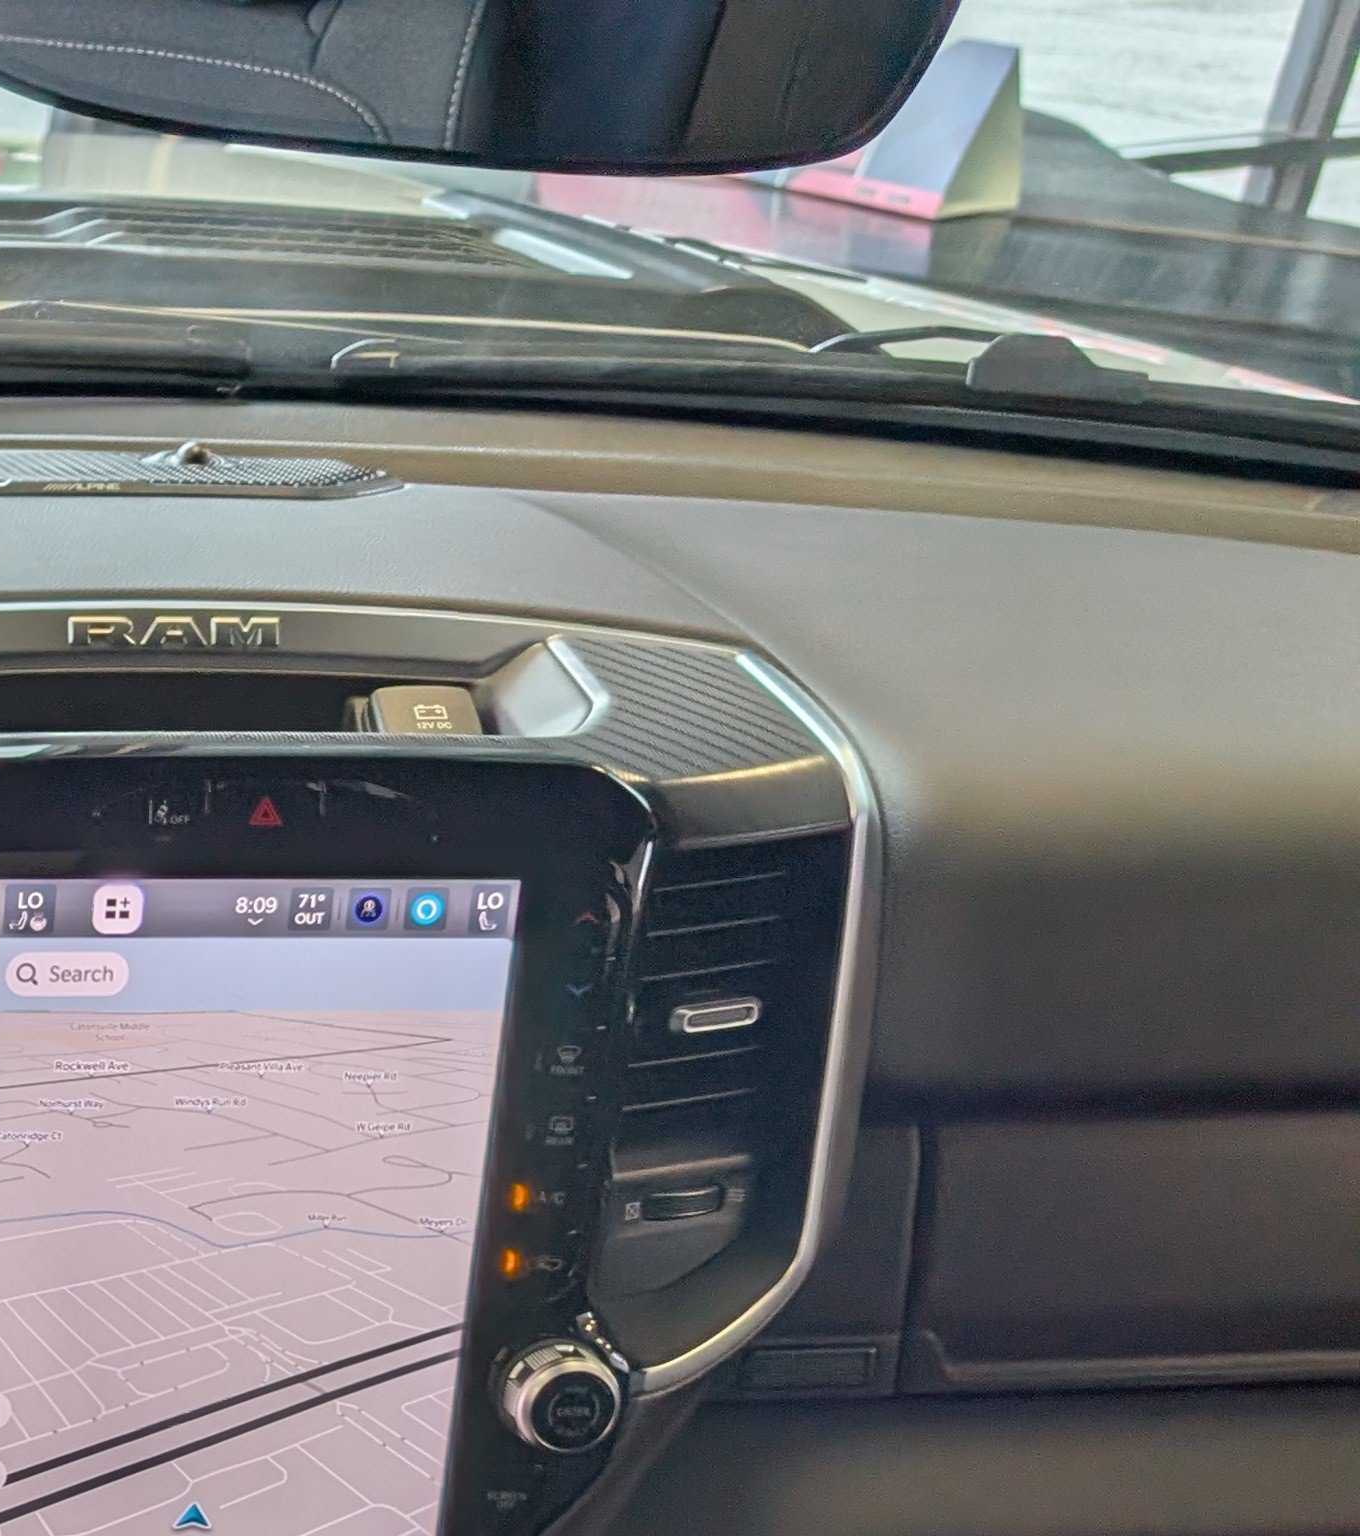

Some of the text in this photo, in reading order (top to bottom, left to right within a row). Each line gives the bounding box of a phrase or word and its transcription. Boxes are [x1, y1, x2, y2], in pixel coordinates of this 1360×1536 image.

[67, 615, 280, 646] RAM
[416, 720, 452, 729] 12V DC
[170, 813, 190, 825] OFF
[17, 891, 43, 909] LO
[234, 896, 278, 914] 8:09
[298, 893, 326, 909] 71°
[476, 892, 503, 910] LO
[294, 911, 325, 925] OUT
[48, 965, 114, 983] Search
[54, 1060, 130, 1071] Rockwell Ave
[383, 1072, 397, 1081] Rd
